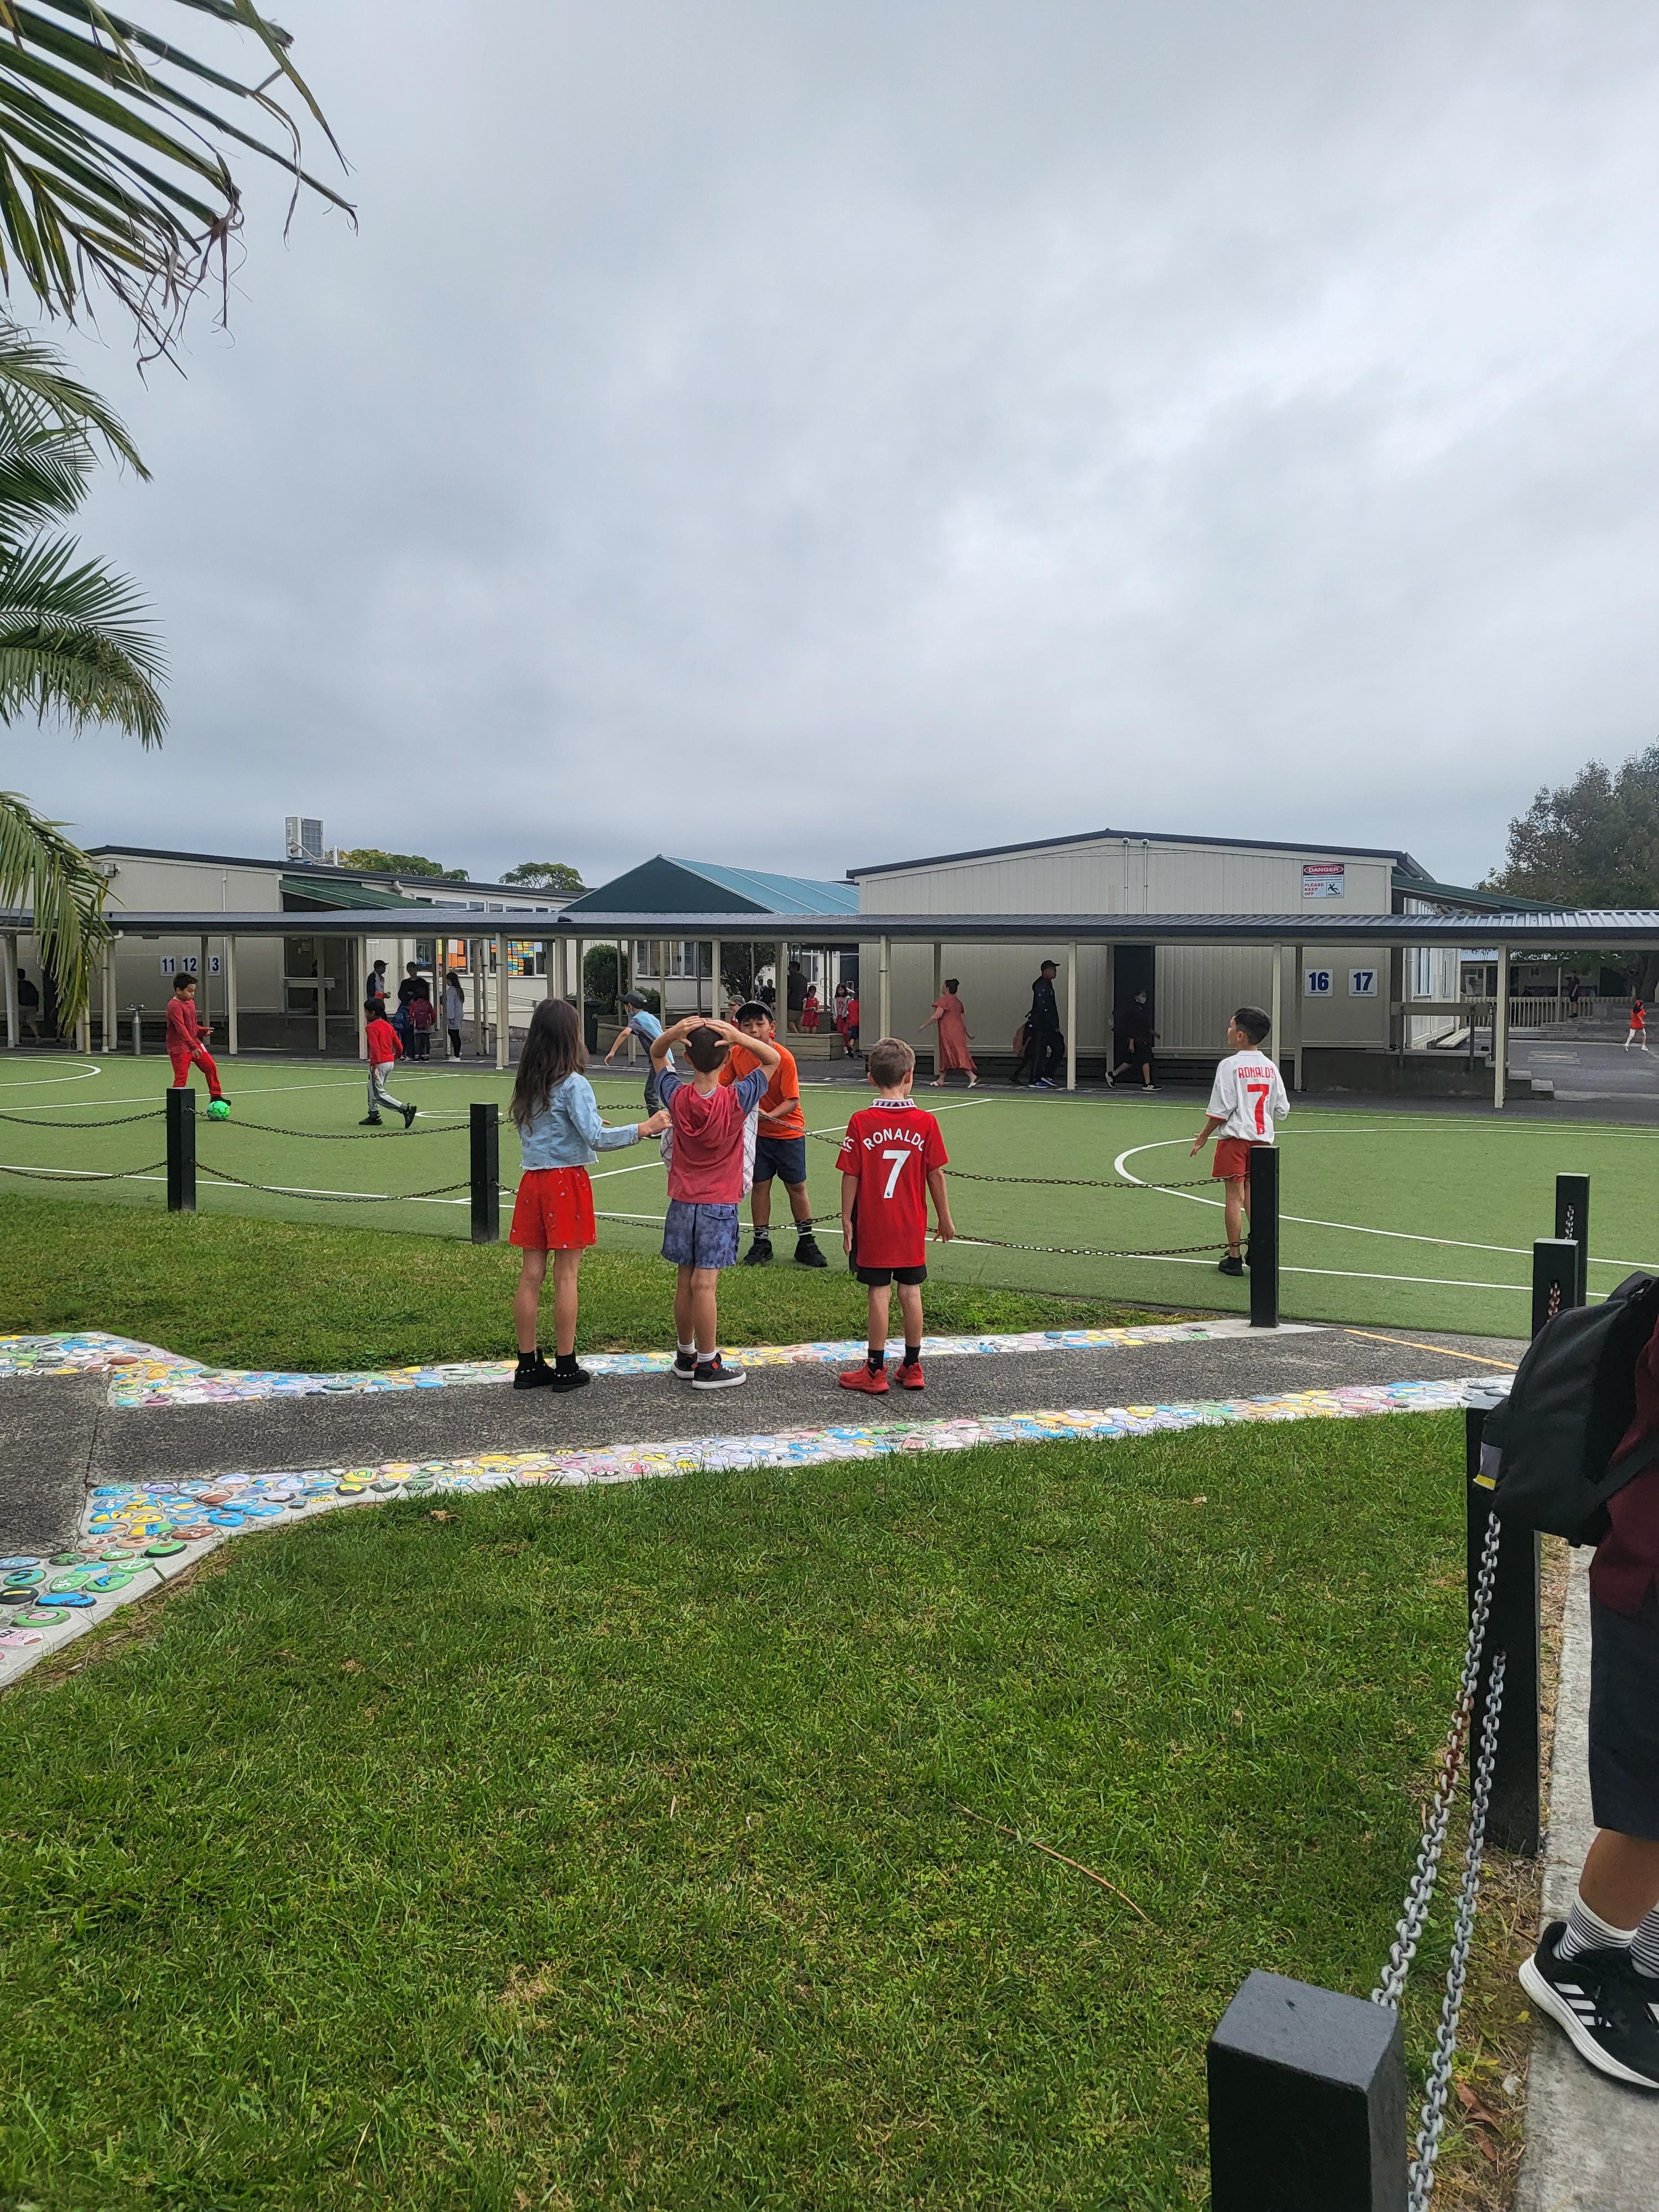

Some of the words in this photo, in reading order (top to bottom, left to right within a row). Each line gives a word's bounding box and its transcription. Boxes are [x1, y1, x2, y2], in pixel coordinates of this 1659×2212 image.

[163, 958, 174, 972] 11
[182, 957, 197, 972] 12
[1530, 968, 1540, 977] 14
[1308, 972, 1329, 991] 16
[1353, 972, 1373, 991] 17
[1238, 1066, 1274, 1079] RONALDO
[1246, 1083, 1270, 1135] 7
[882, 1150, 911, 1199] 7
